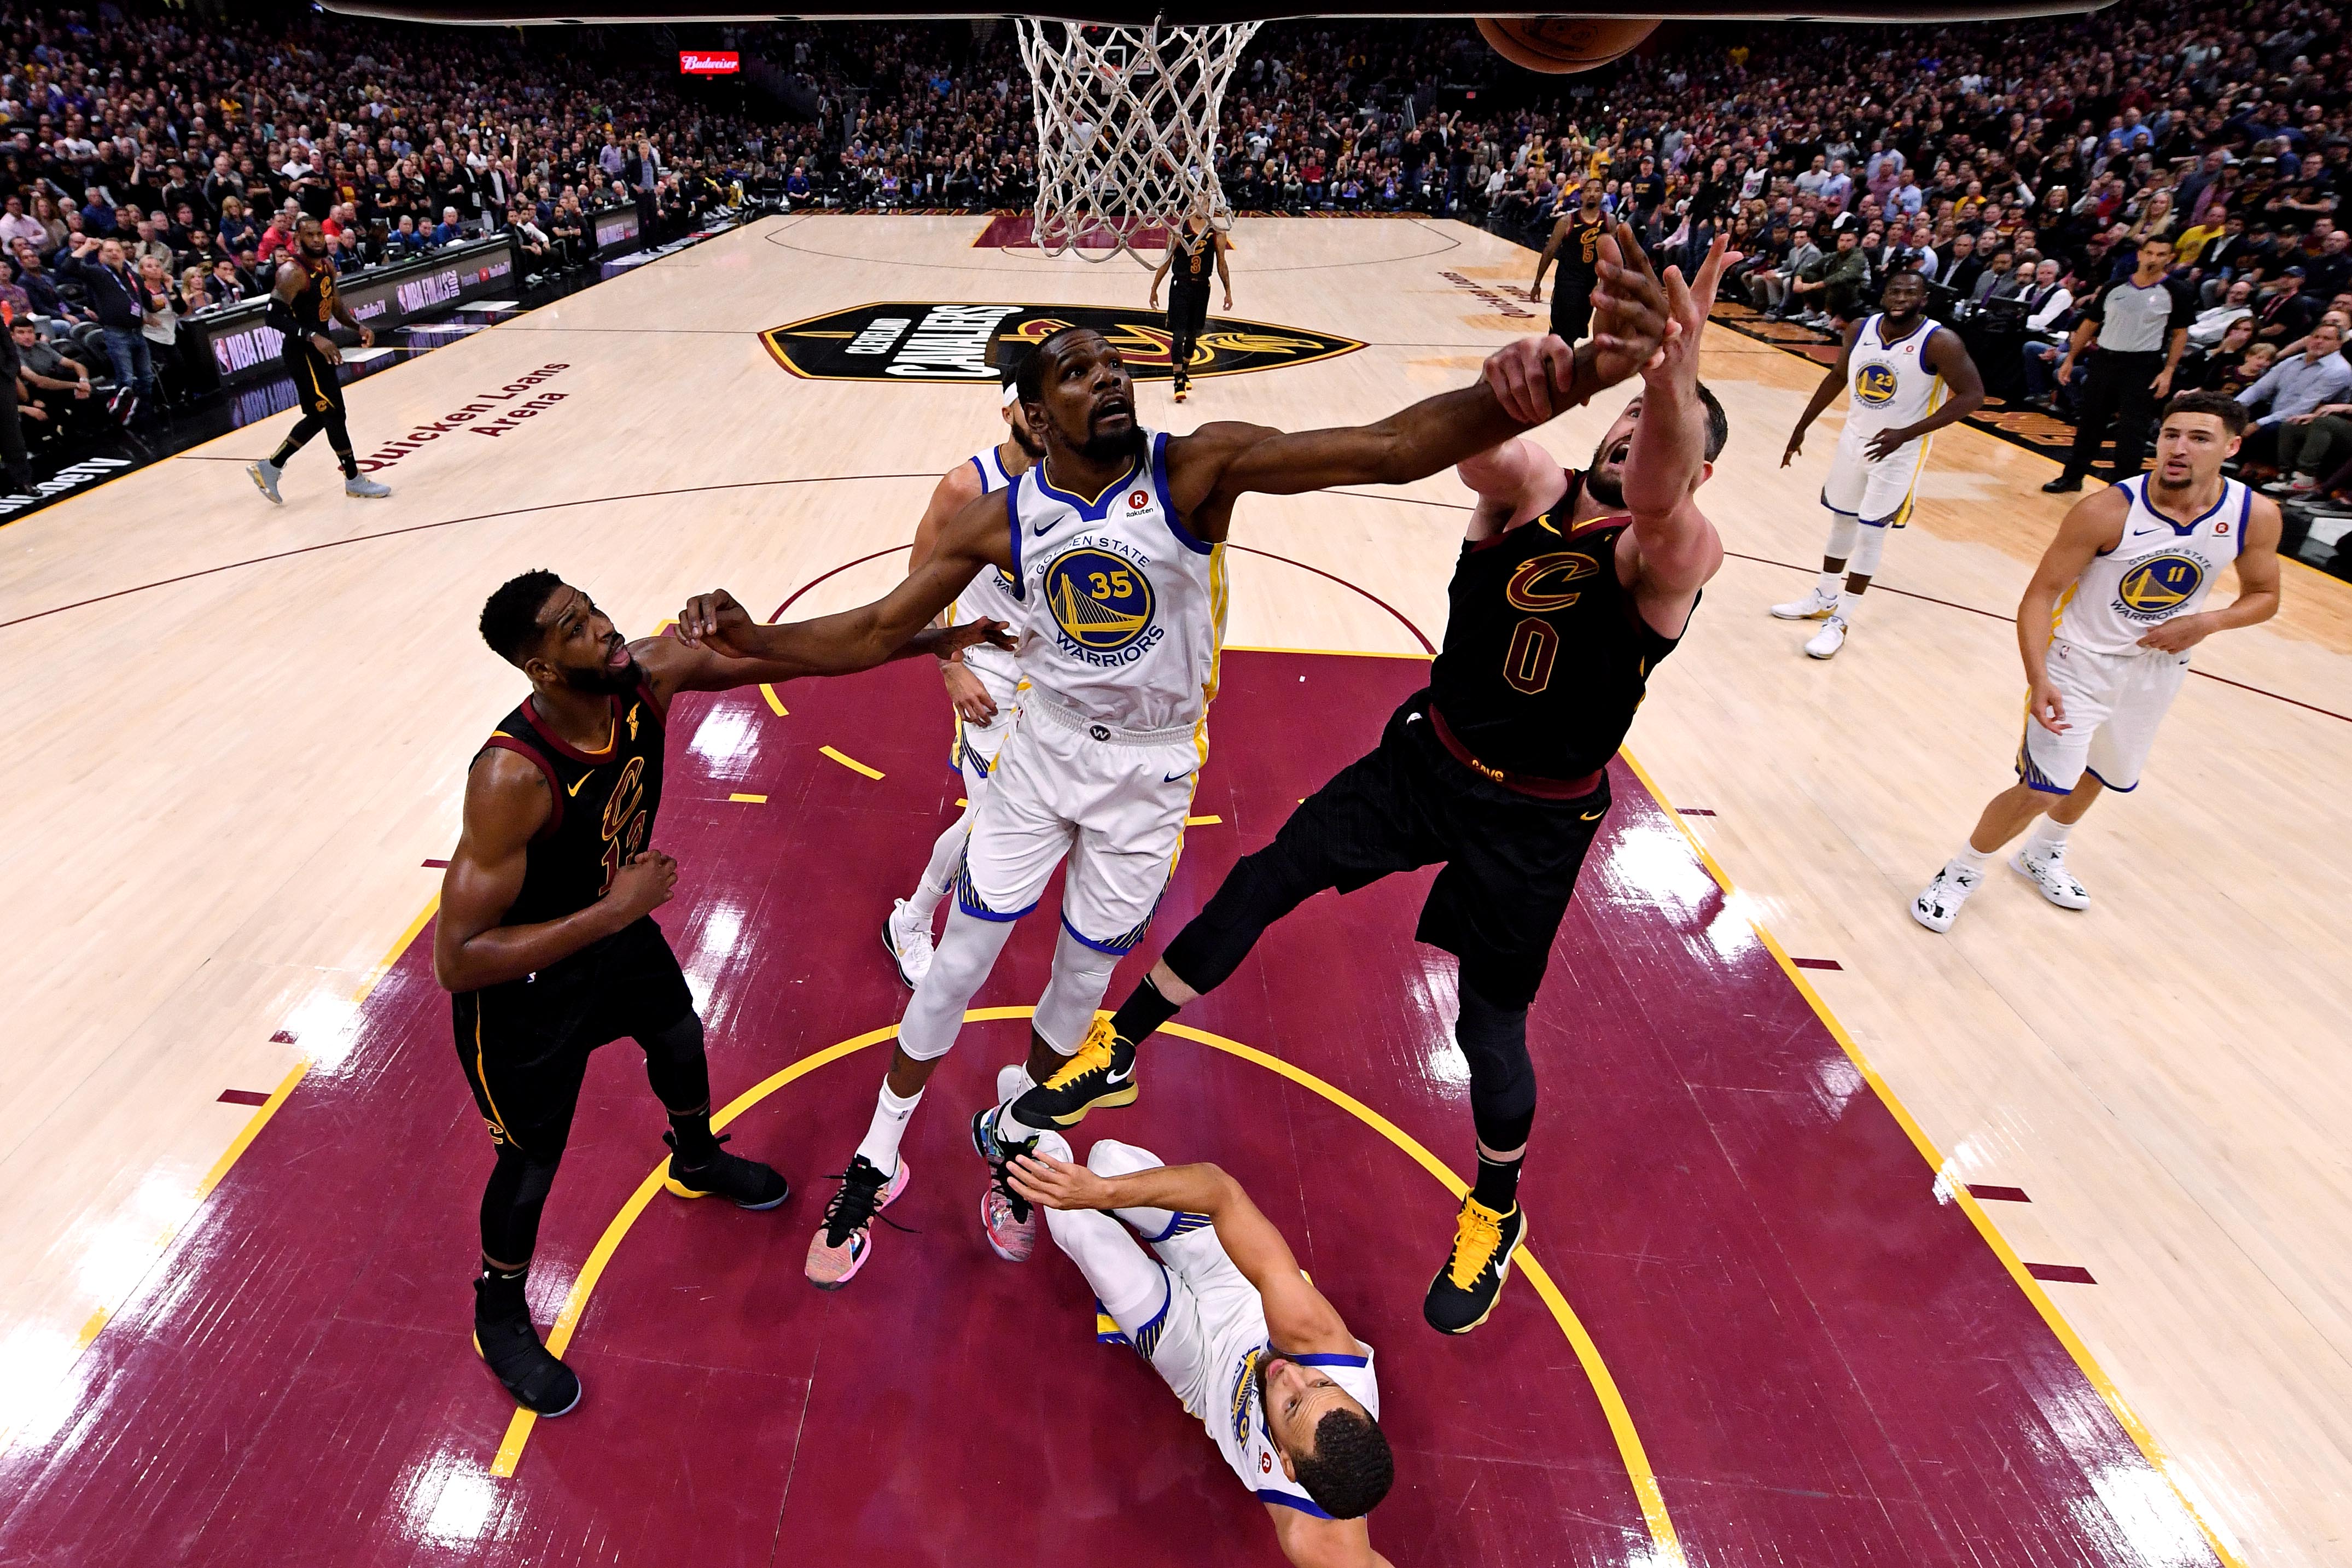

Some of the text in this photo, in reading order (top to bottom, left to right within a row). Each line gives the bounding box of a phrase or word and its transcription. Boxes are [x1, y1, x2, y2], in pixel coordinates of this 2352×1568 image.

[682, 56, 737, 70] Budweiser
[1190, 255, 1201, 273] 3
[1582, 244, 1594, 263] 5
[404, 280, 426, 312] NBA
[421, 272, 450, 306] FINALS
[447, 270, 461, 298] 2018
[225, 326, 283, 371] NBA FINA
[845, 318, 912, 354] CLEVELAND
[884, 305, 1024, 377] CAVALIERS
[1875, 373, 1894, 387] 23
[469, 392, 569, 437] Arena
[1854, 392, 1896, 410] WARRIORS
[337, 363, 570, 473] Quicken Loans
[1126, 508, 1154, 518] Rakuten
[1099, 537, 1150, 568] STATE
[2128, 548, 2213, 570] GOLDEN STATE
[1088, 570, 1133, 600] 35
[1506, 551, 1600, 612] C
[2167, 567, 2187, 582] 11
[2110, 599, 2189, 621] WARRIORS
[1056, 625, 1165, 667] WARRIORS
[1503, 616, 1559, 695] 0
